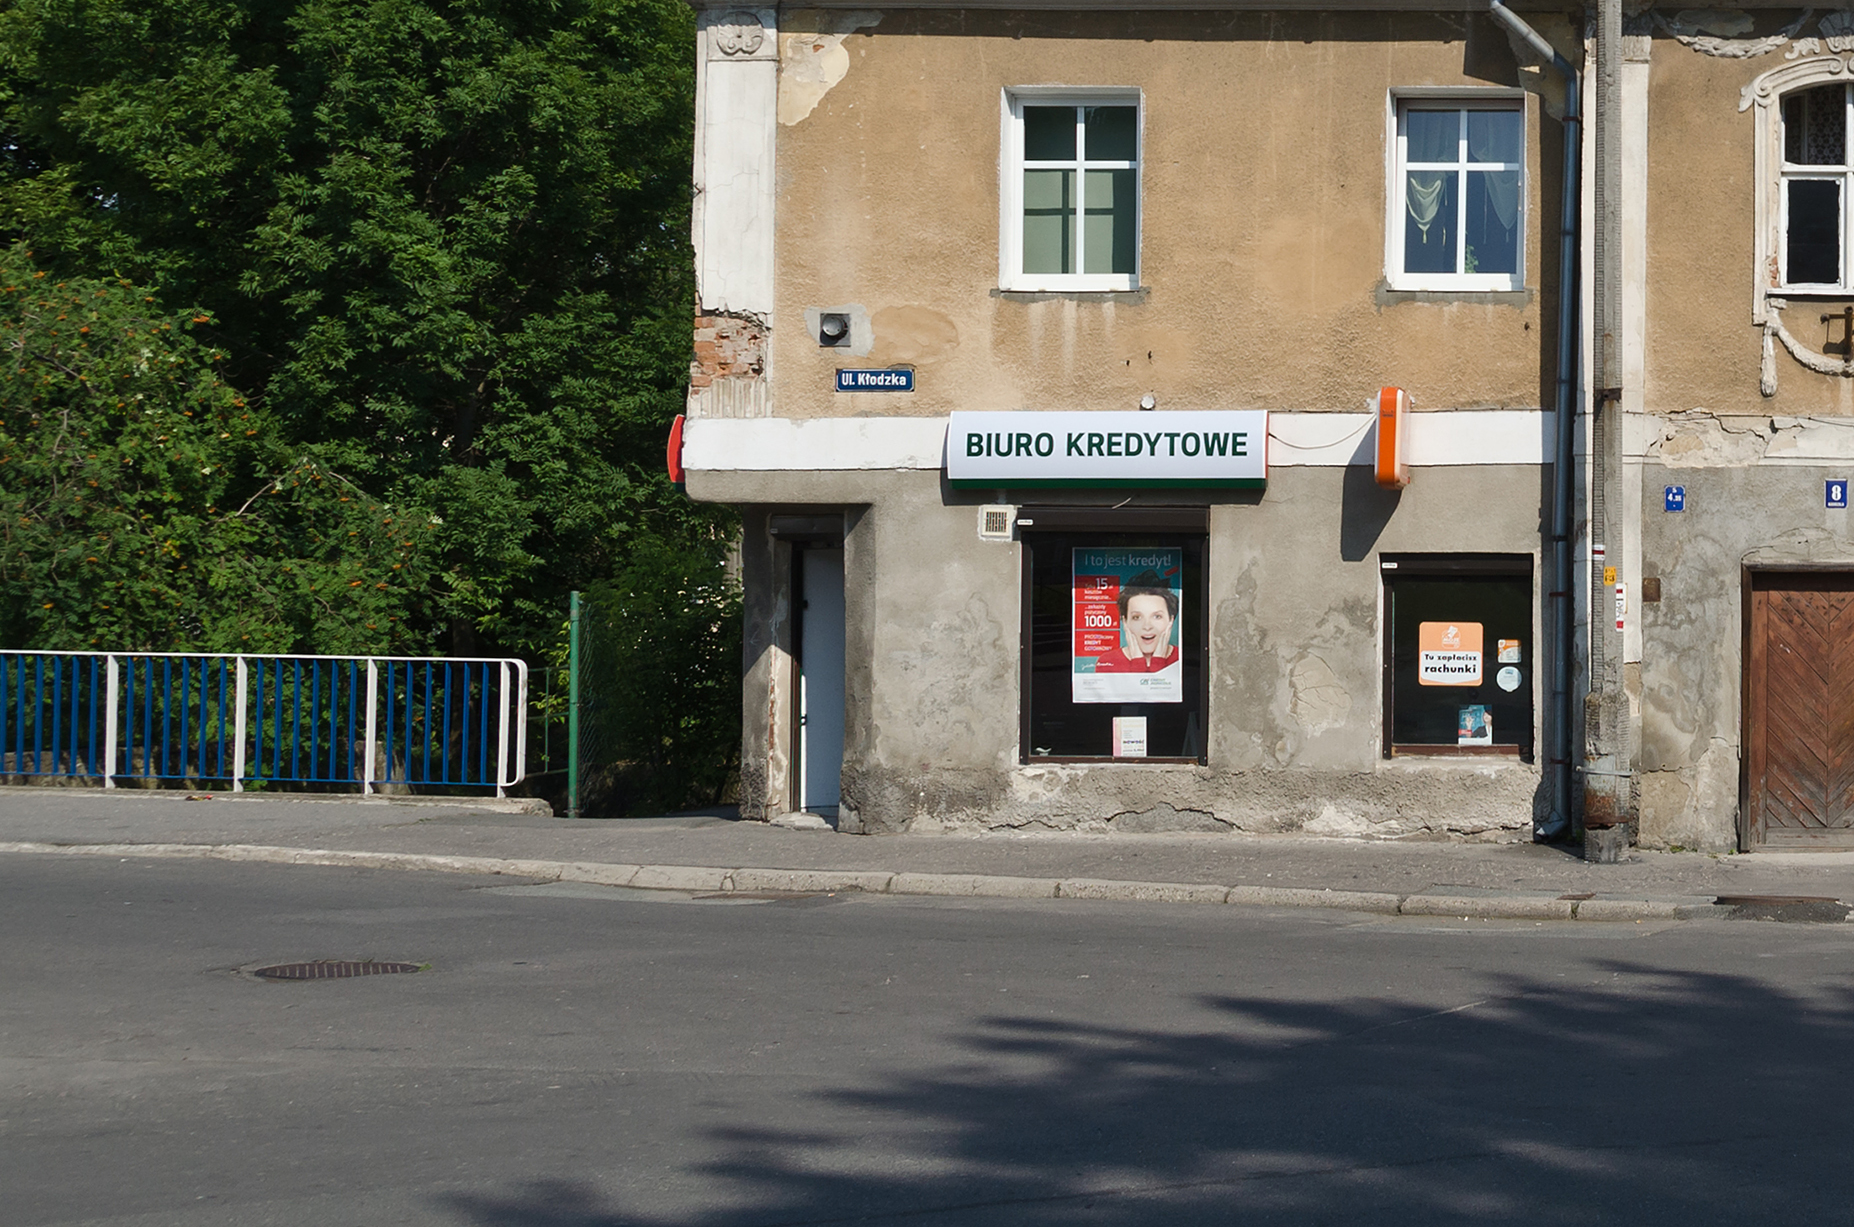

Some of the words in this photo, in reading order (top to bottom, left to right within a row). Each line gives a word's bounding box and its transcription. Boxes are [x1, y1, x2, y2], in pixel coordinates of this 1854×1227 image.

[841, 372, 856, 386] Ul.
[857, 372, 907, 386] Kłodzka
[965, 432, 1055, 457] BIURO
[1065, 432, 1249, 457] KREDYTOWE
[1831, 484, 1842, 501] 8
[1091, 556, 1103, 565] to
[1103, 555, 1126, 569] jest
[1128, 554, 1172, 569] kredyt!
[1095, 578, 1108, 590] 15
[1084, 615, 1112, 627] 1000
[1437, 653, 1477, 662] zapłacisz
[1424, 664, 1477, 673] rachunki
